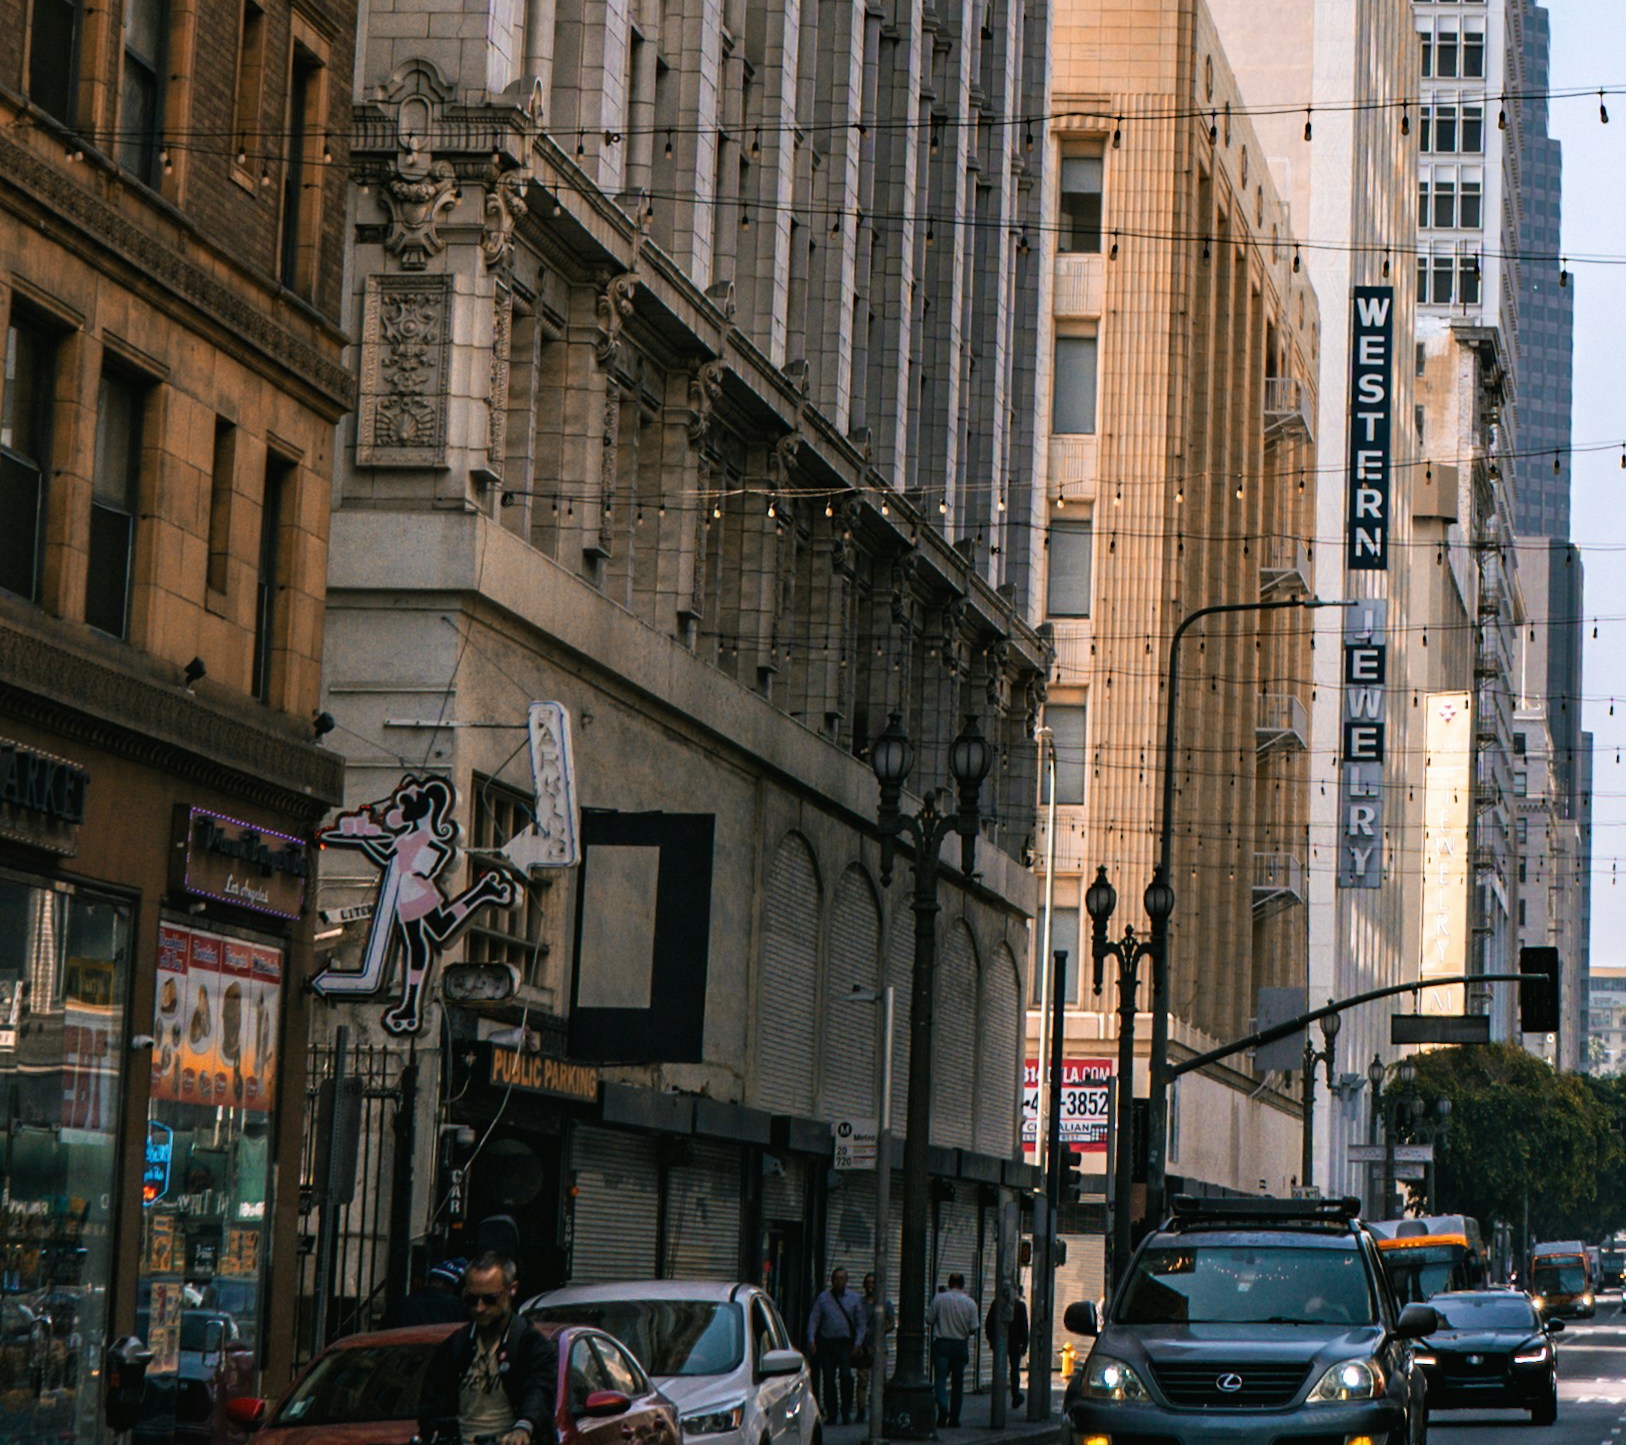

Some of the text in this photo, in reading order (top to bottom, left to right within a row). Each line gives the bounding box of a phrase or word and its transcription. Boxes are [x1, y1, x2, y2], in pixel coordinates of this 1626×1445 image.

[1355, 297, 1390, 557] WESTERN
[1347, 609, 1382, 876] JEWELRY
[1434, 780, 1457, 963] JEWELRY
[493, 1048, 597, 1098] PUBLIC PARKING
[450, 1168, 462, 1213] CAR
